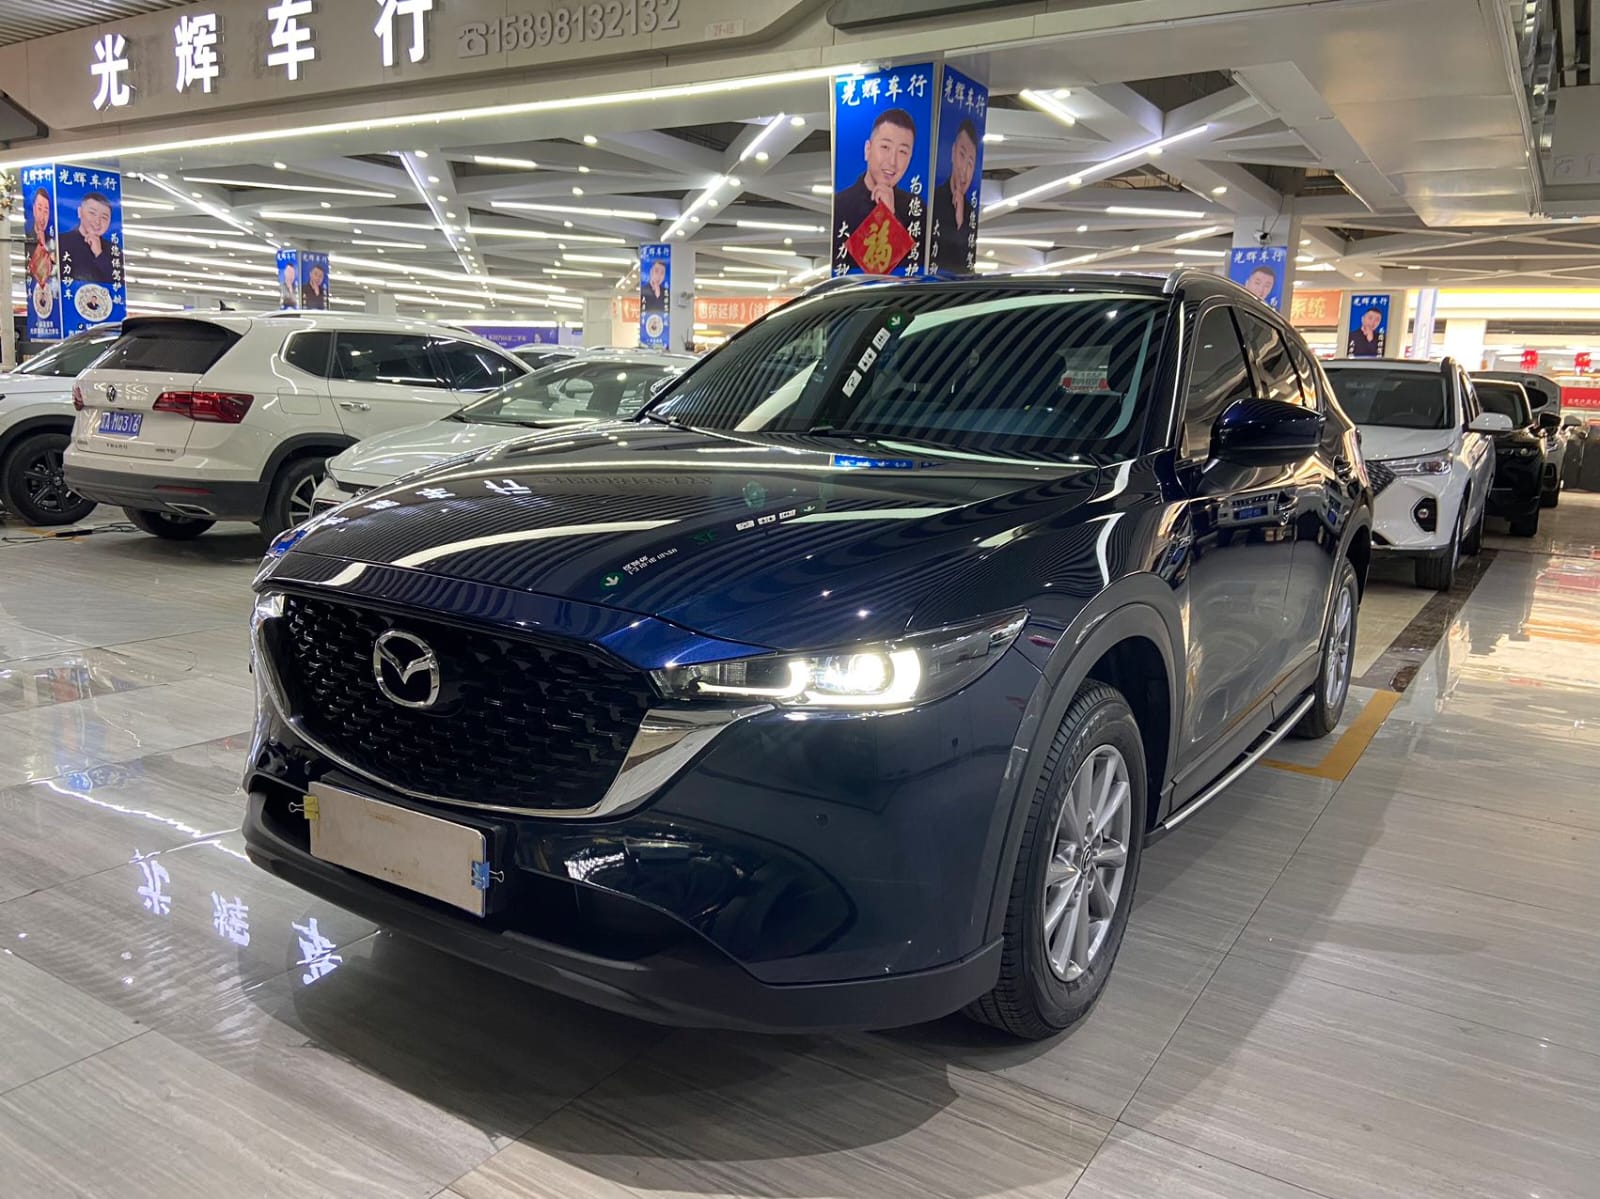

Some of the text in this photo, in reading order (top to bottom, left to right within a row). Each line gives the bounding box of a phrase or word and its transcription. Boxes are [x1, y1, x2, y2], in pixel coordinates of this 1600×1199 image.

[490, 0, 680, 53] 15898132132
[90, 0, 434, 112] 光辉车行
[841, 73, 928, 106] 光辉车行
[944, 75, 986, 118] 光辉车行
[58, 168, 118, 191] 光辉车行
[863, 221, 892, 273] 福
